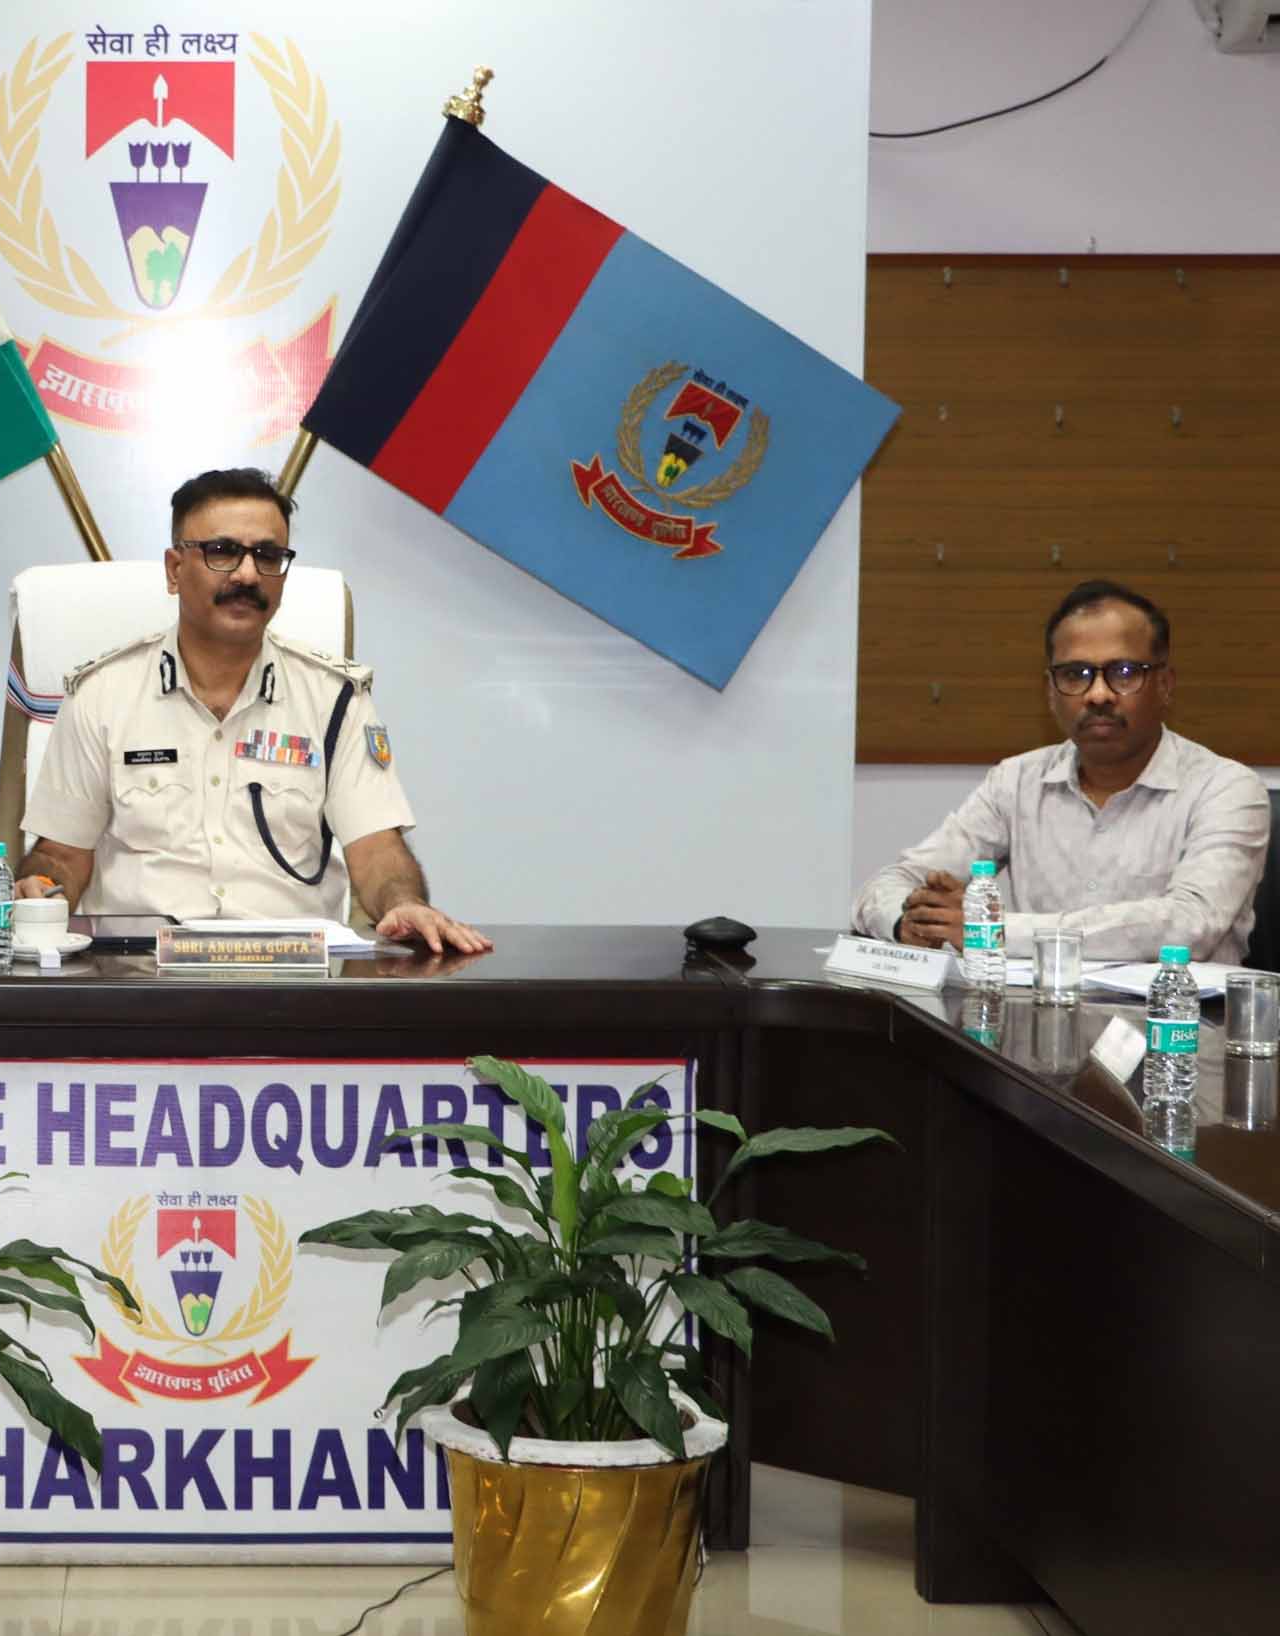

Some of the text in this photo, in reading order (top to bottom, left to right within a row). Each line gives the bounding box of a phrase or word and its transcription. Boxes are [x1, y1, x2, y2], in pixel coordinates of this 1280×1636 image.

[85, 24, 238, 56] सेवा ही लक्ष्य
[174, 941, 309, 953] SHRI ANURAG GUPTA
[157, 1190, 238, 1208] सेवा ही लक्ष्य
